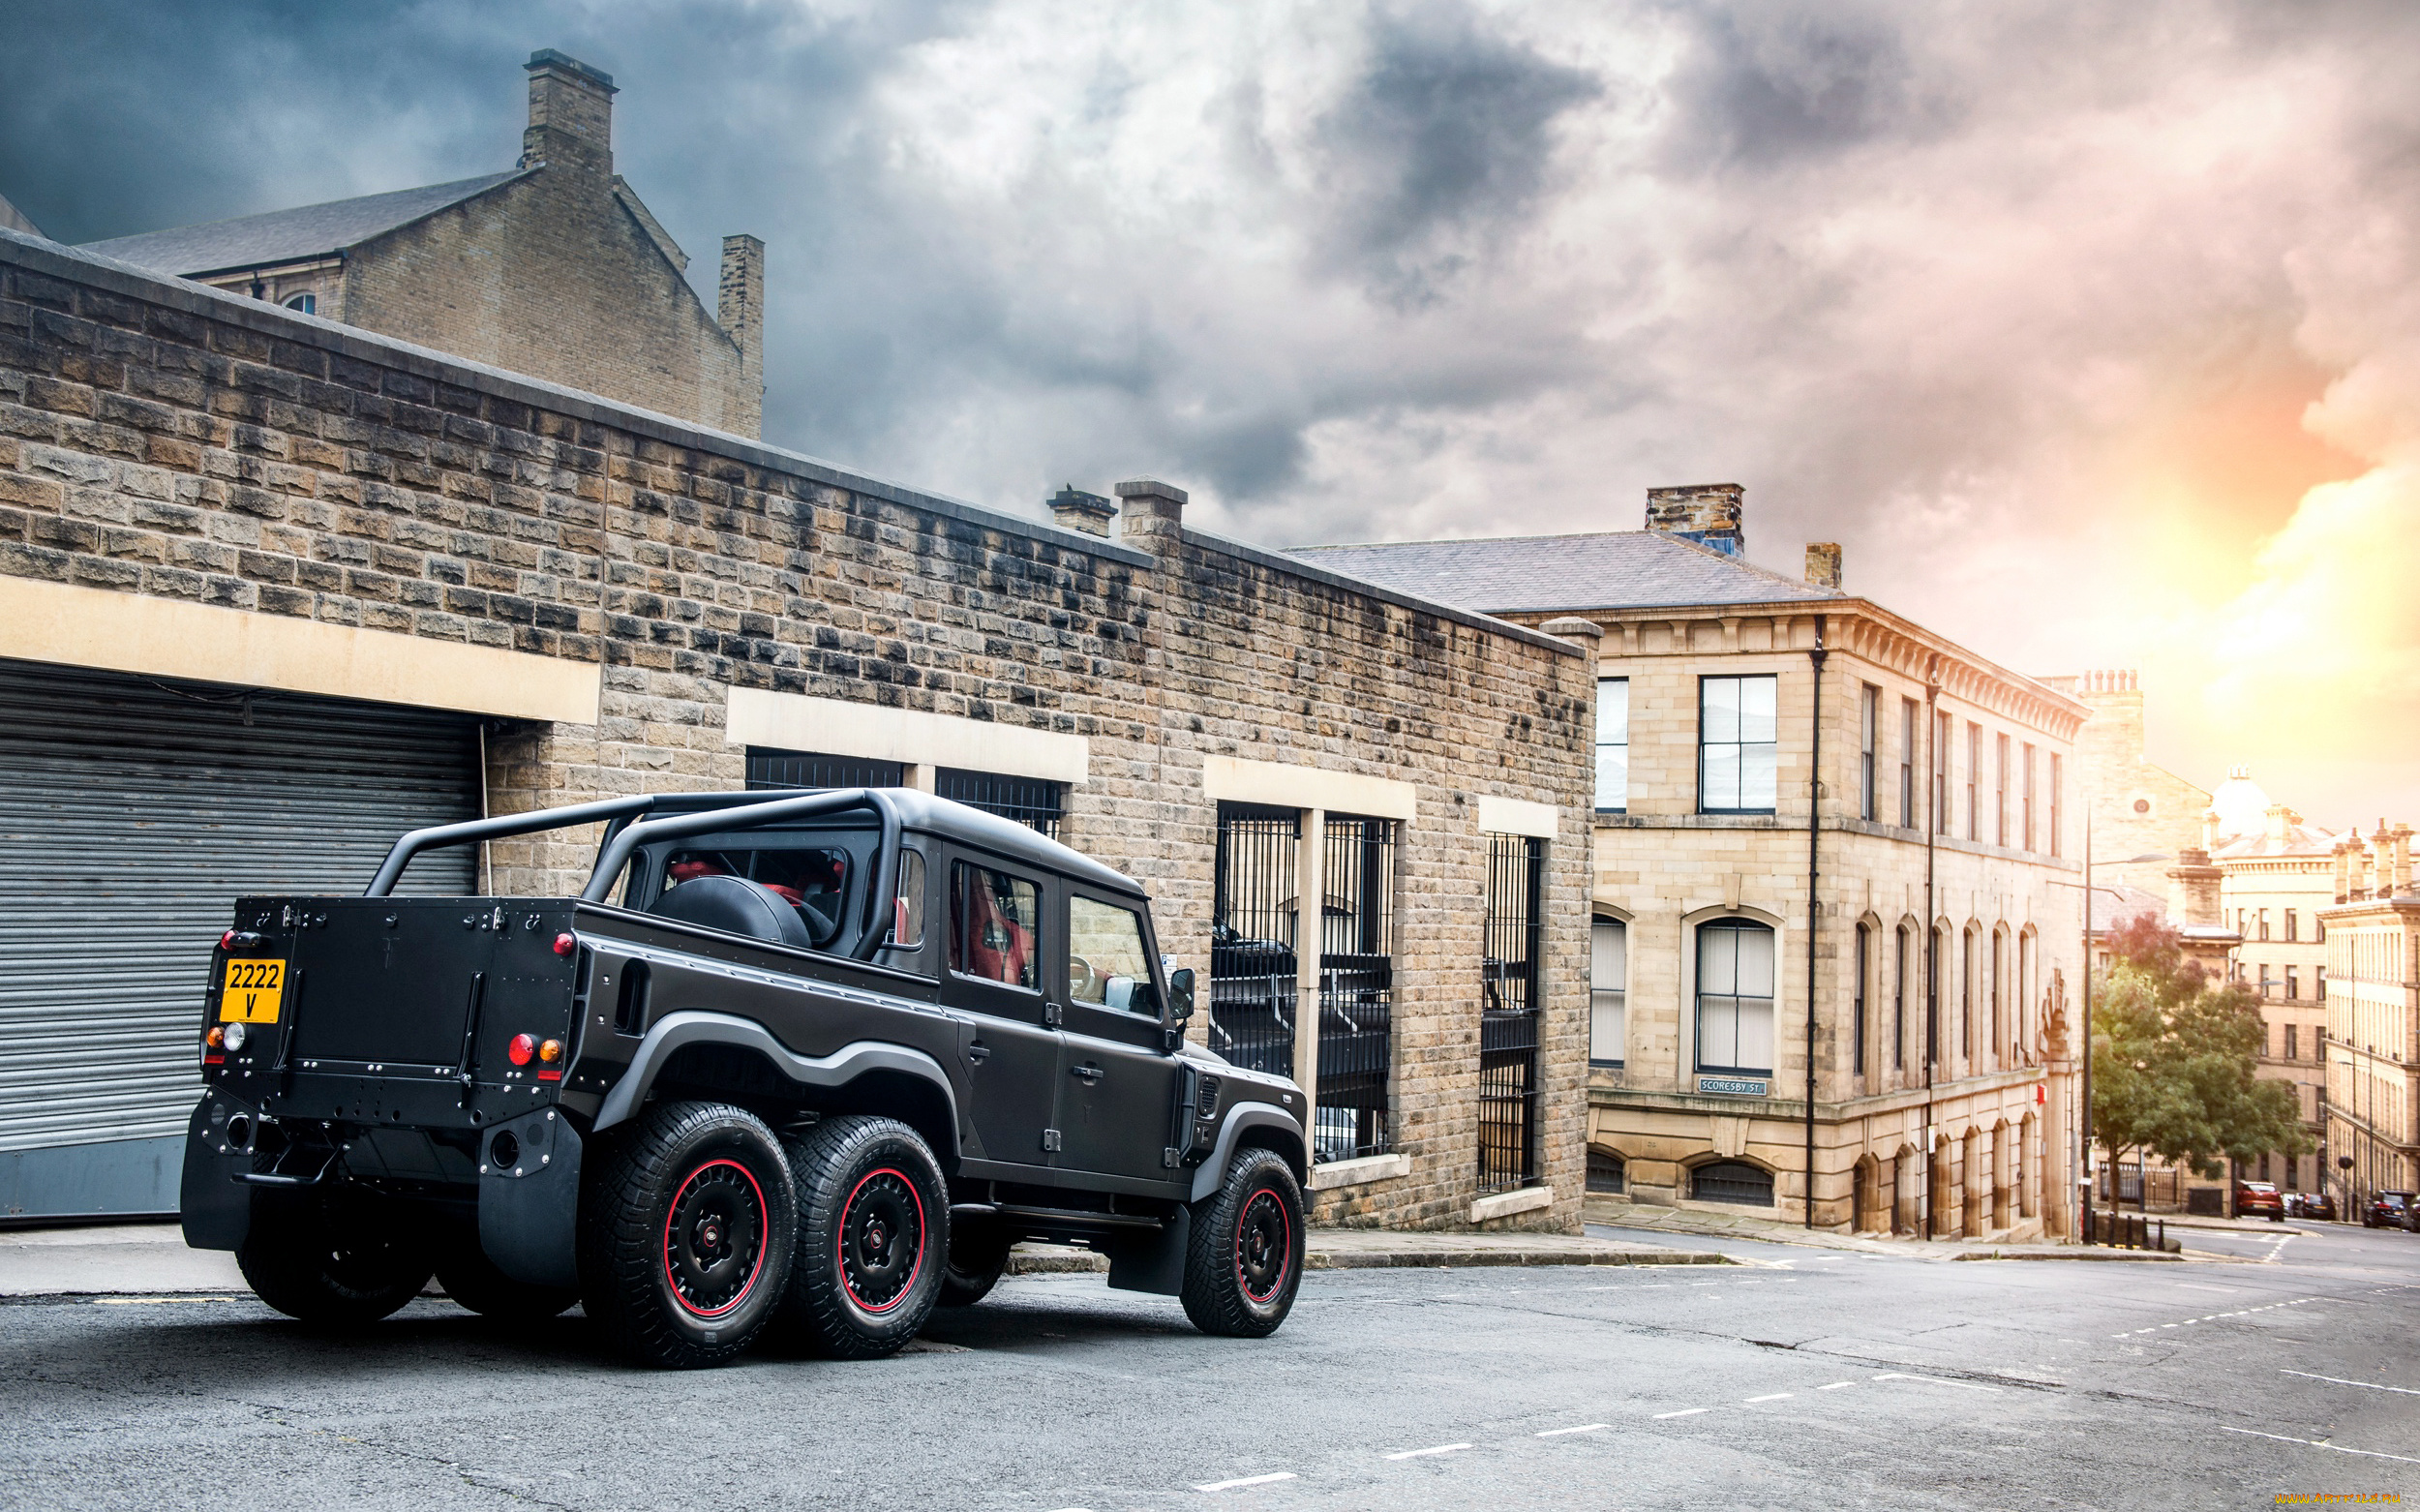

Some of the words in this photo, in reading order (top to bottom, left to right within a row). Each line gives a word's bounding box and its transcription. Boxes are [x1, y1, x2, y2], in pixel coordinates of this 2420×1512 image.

[229, 964, 279, 988] 2222
[247, 993, 257, 1018] V
[1702, 1080, 1746, 1091] SCORESBY
